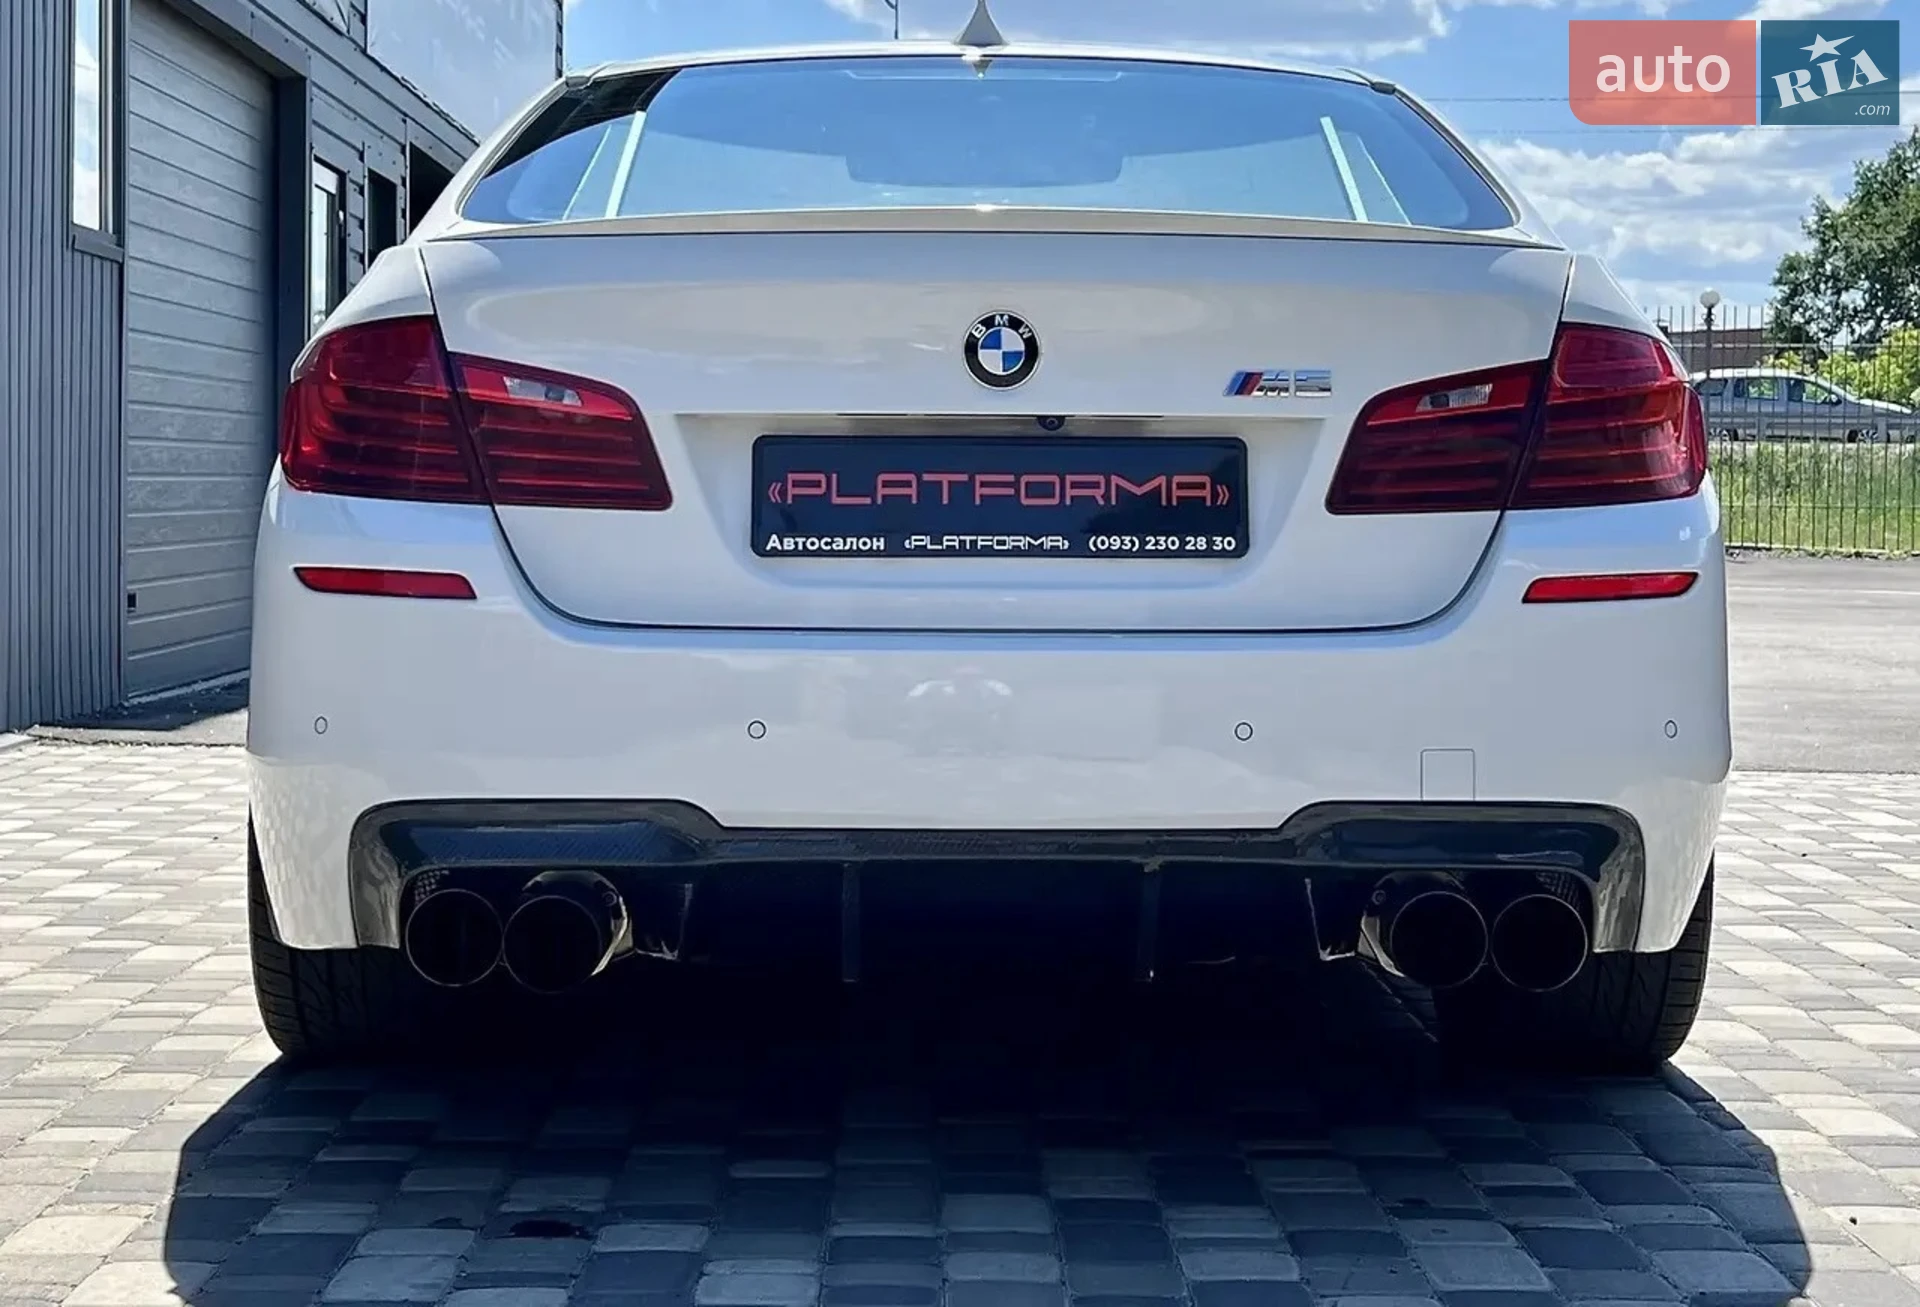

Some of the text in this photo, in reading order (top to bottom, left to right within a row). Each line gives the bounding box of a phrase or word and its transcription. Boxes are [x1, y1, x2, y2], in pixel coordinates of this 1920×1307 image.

[971, 314, 1033, 339] BMW
[1246, 370, 1332, 397] M5
[765, 533, 885, 551] Автосалон
[1089, 535, 1140, 552] (093)
[1144, 536, 1180, 551] 230
[1184, 536, 1207, 551] 28
[1212, 536, 1236, 551] 30
